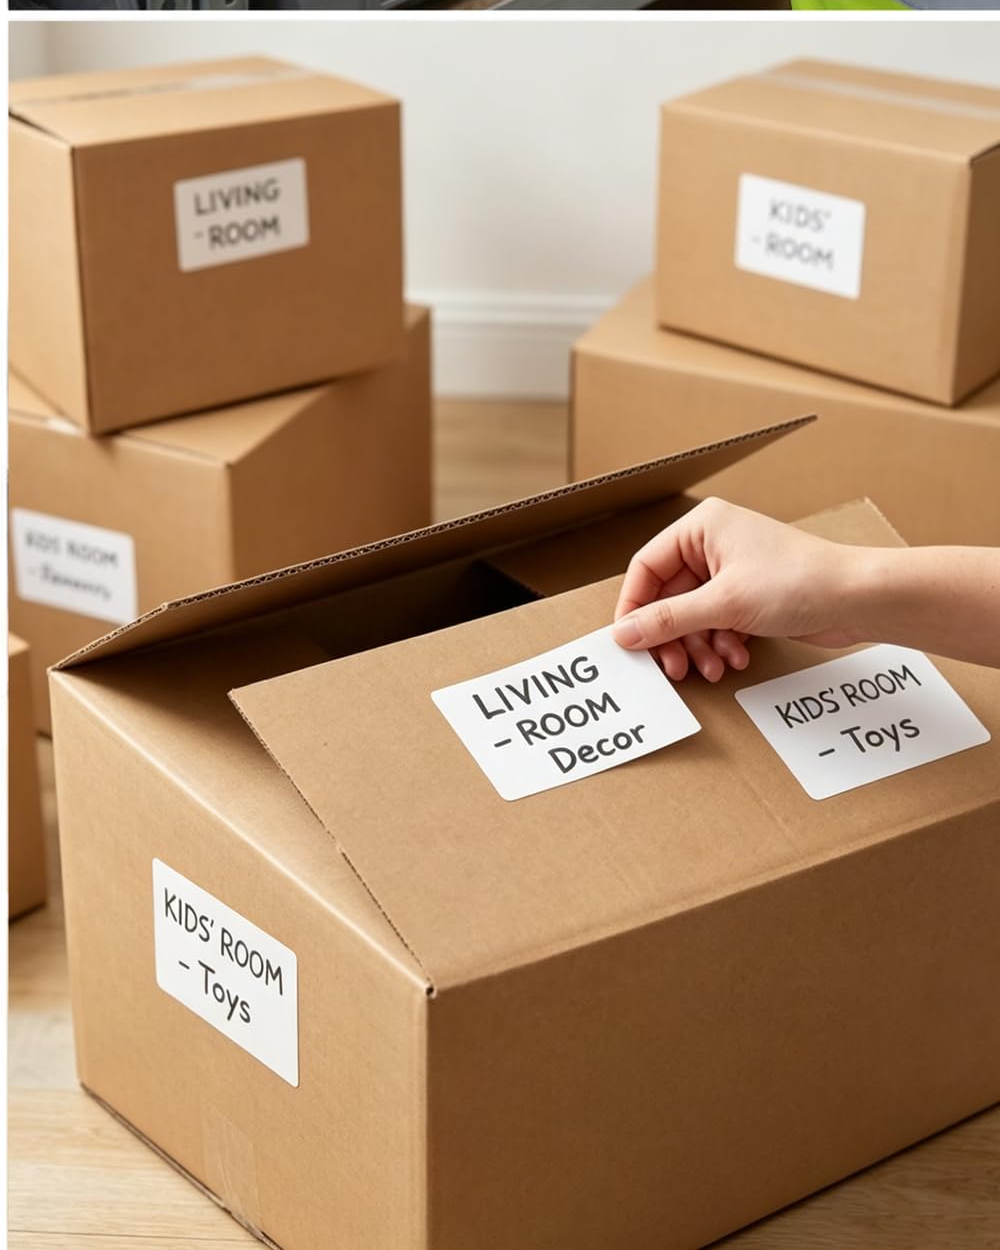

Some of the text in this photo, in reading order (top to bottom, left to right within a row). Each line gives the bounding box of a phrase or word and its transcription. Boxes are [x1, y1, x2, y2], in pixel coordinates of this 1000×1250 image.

[193, 177, 281, 217] LIVING
[207, 215, 281, 249] ROOM
[765, 231, 835, 271] ROOM
[472, 655, 600, 720] LIVING
[774, 664, 922, 729] KIDS' ROOM
[516, 692, 621, 746] ROOM
[840, 718, 921, 753] Toys
[548, 724, 645, 774] Decor
[163, 887, 284, 996] KIDS' ROOM
[197, 959, 251, 1024] Toys
